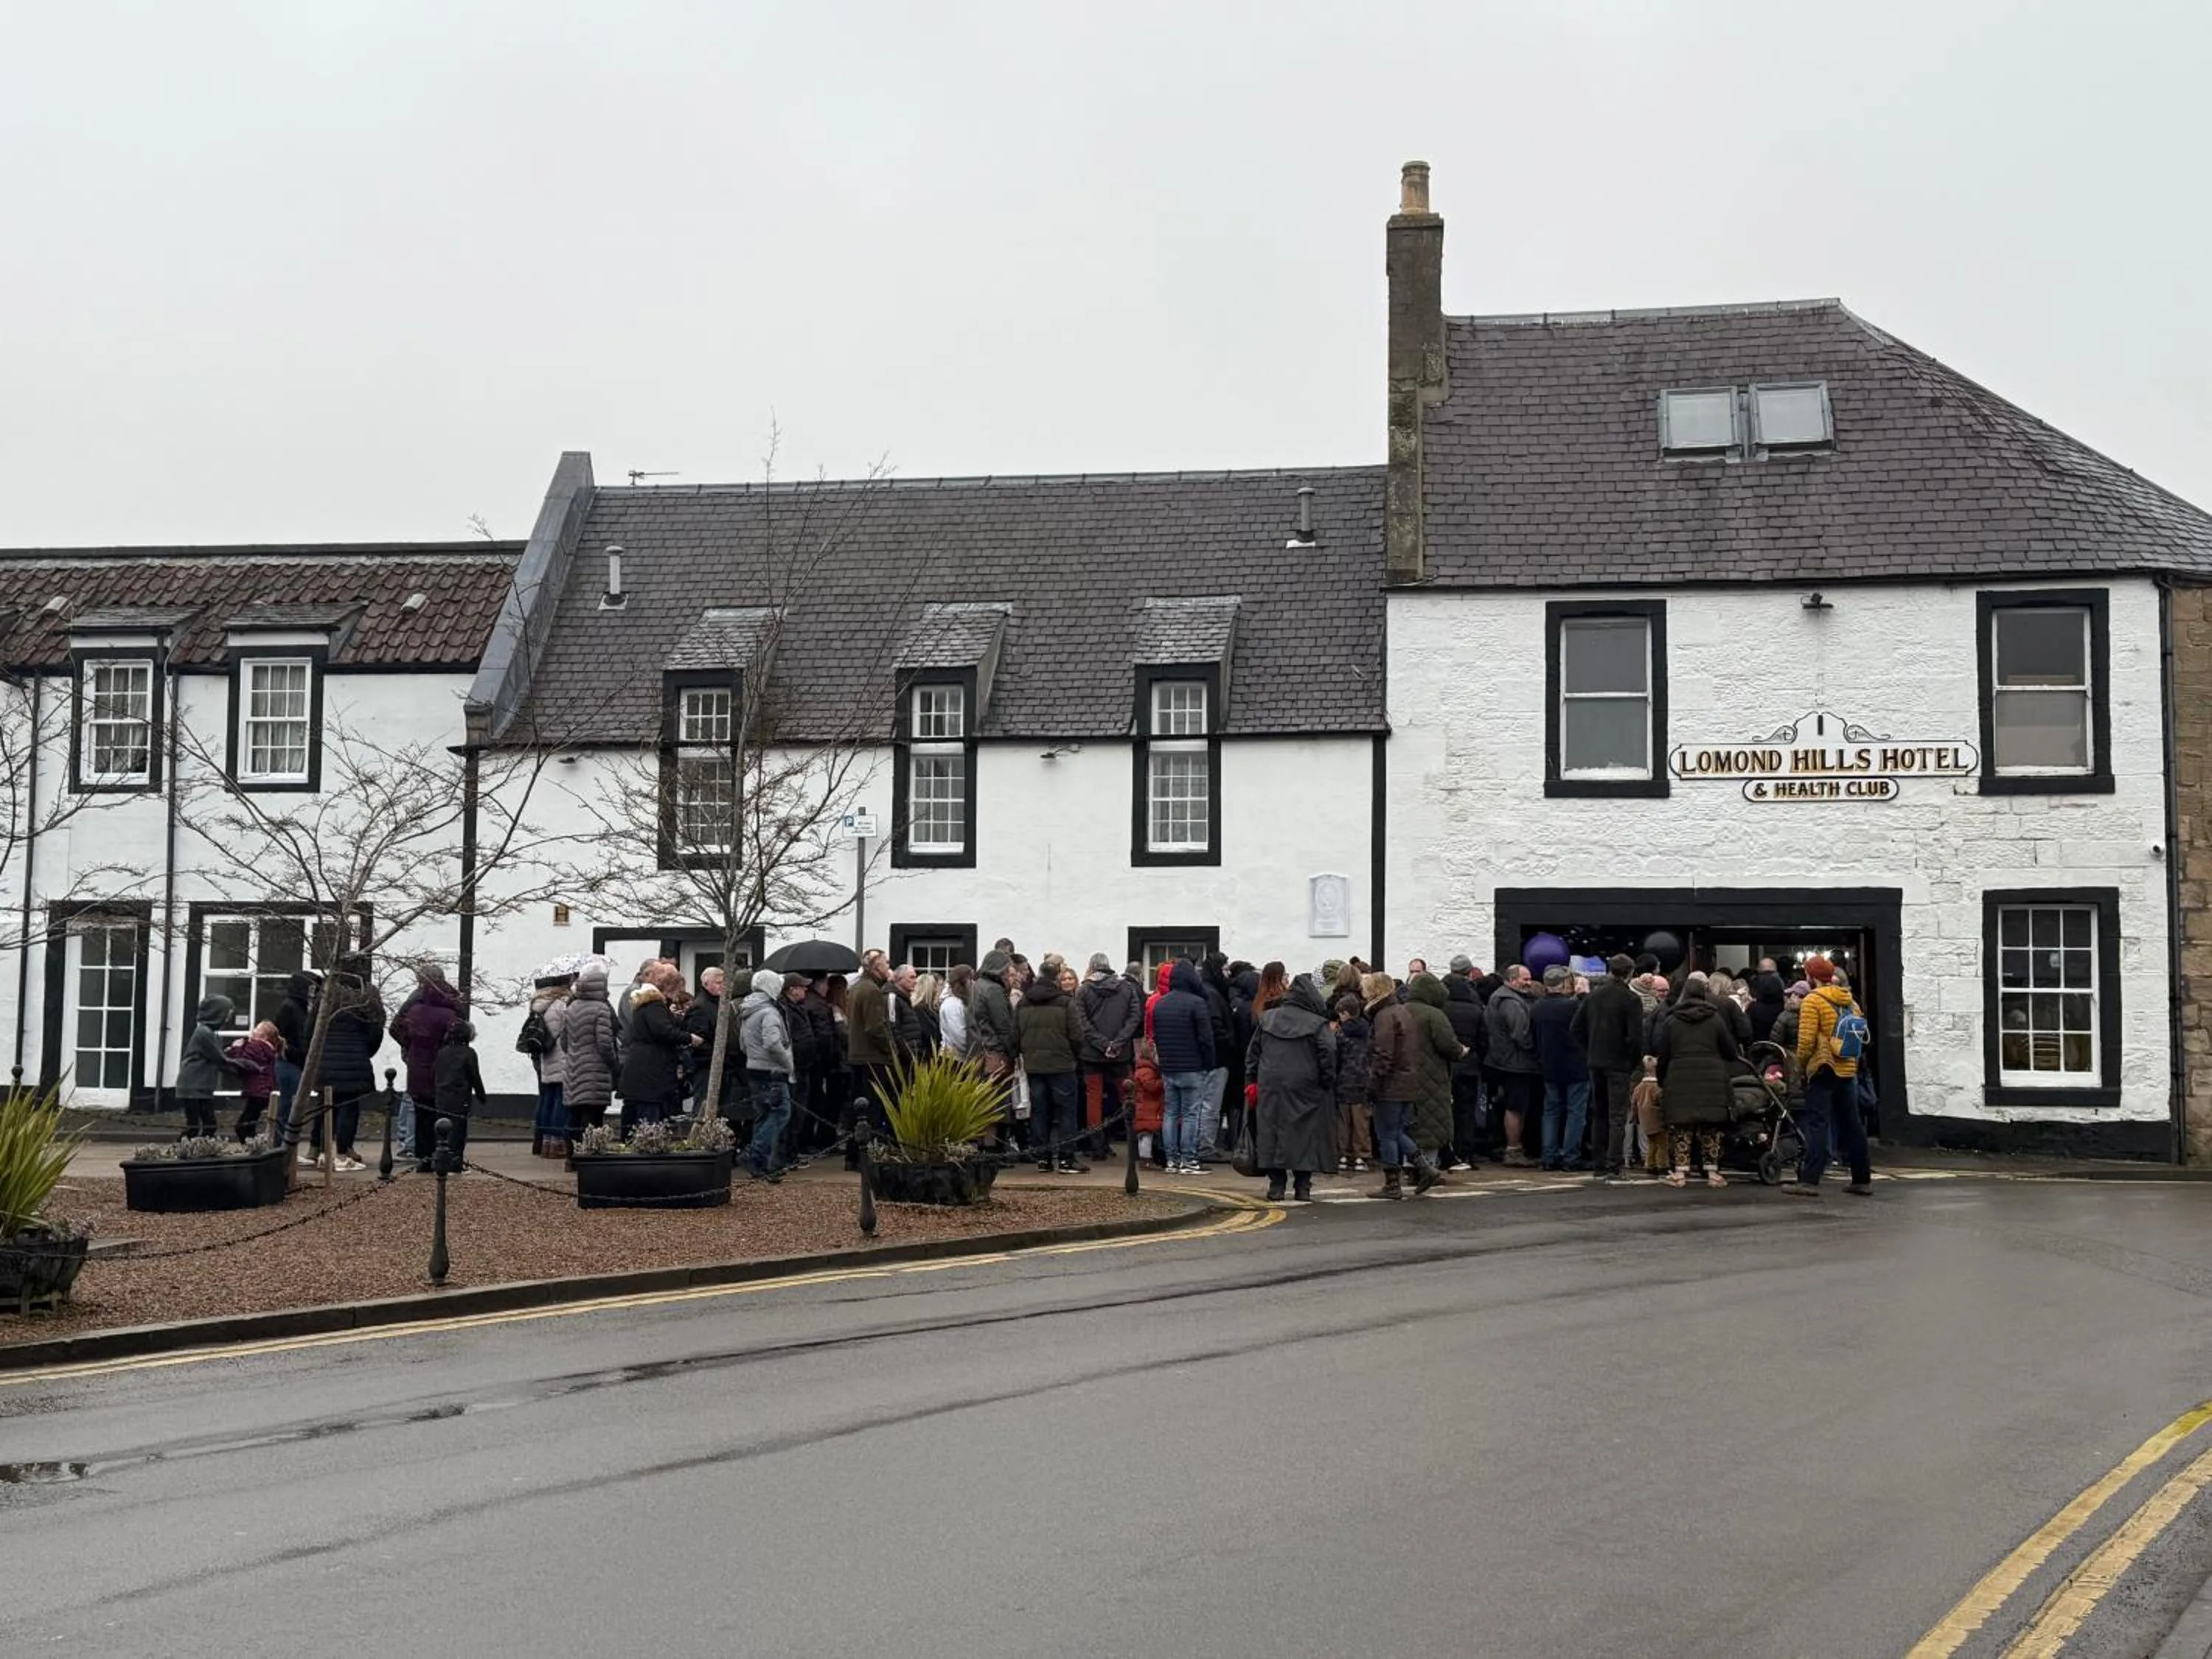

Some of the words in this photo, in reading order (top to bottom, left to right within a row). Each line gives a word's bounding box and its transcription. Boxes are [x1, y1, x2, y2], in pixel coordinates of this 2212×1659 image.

[1680, 750, 1782, 773] LOMOND
[1790, 748, 1871, 773] HILLS
[1879, 747, 1969, 772] HOTEL
[1753, 782, 1767, 797] &
[1774, 781, 1840, 798] HEALTH
[1846, 781, 1890, 797] CLUB
